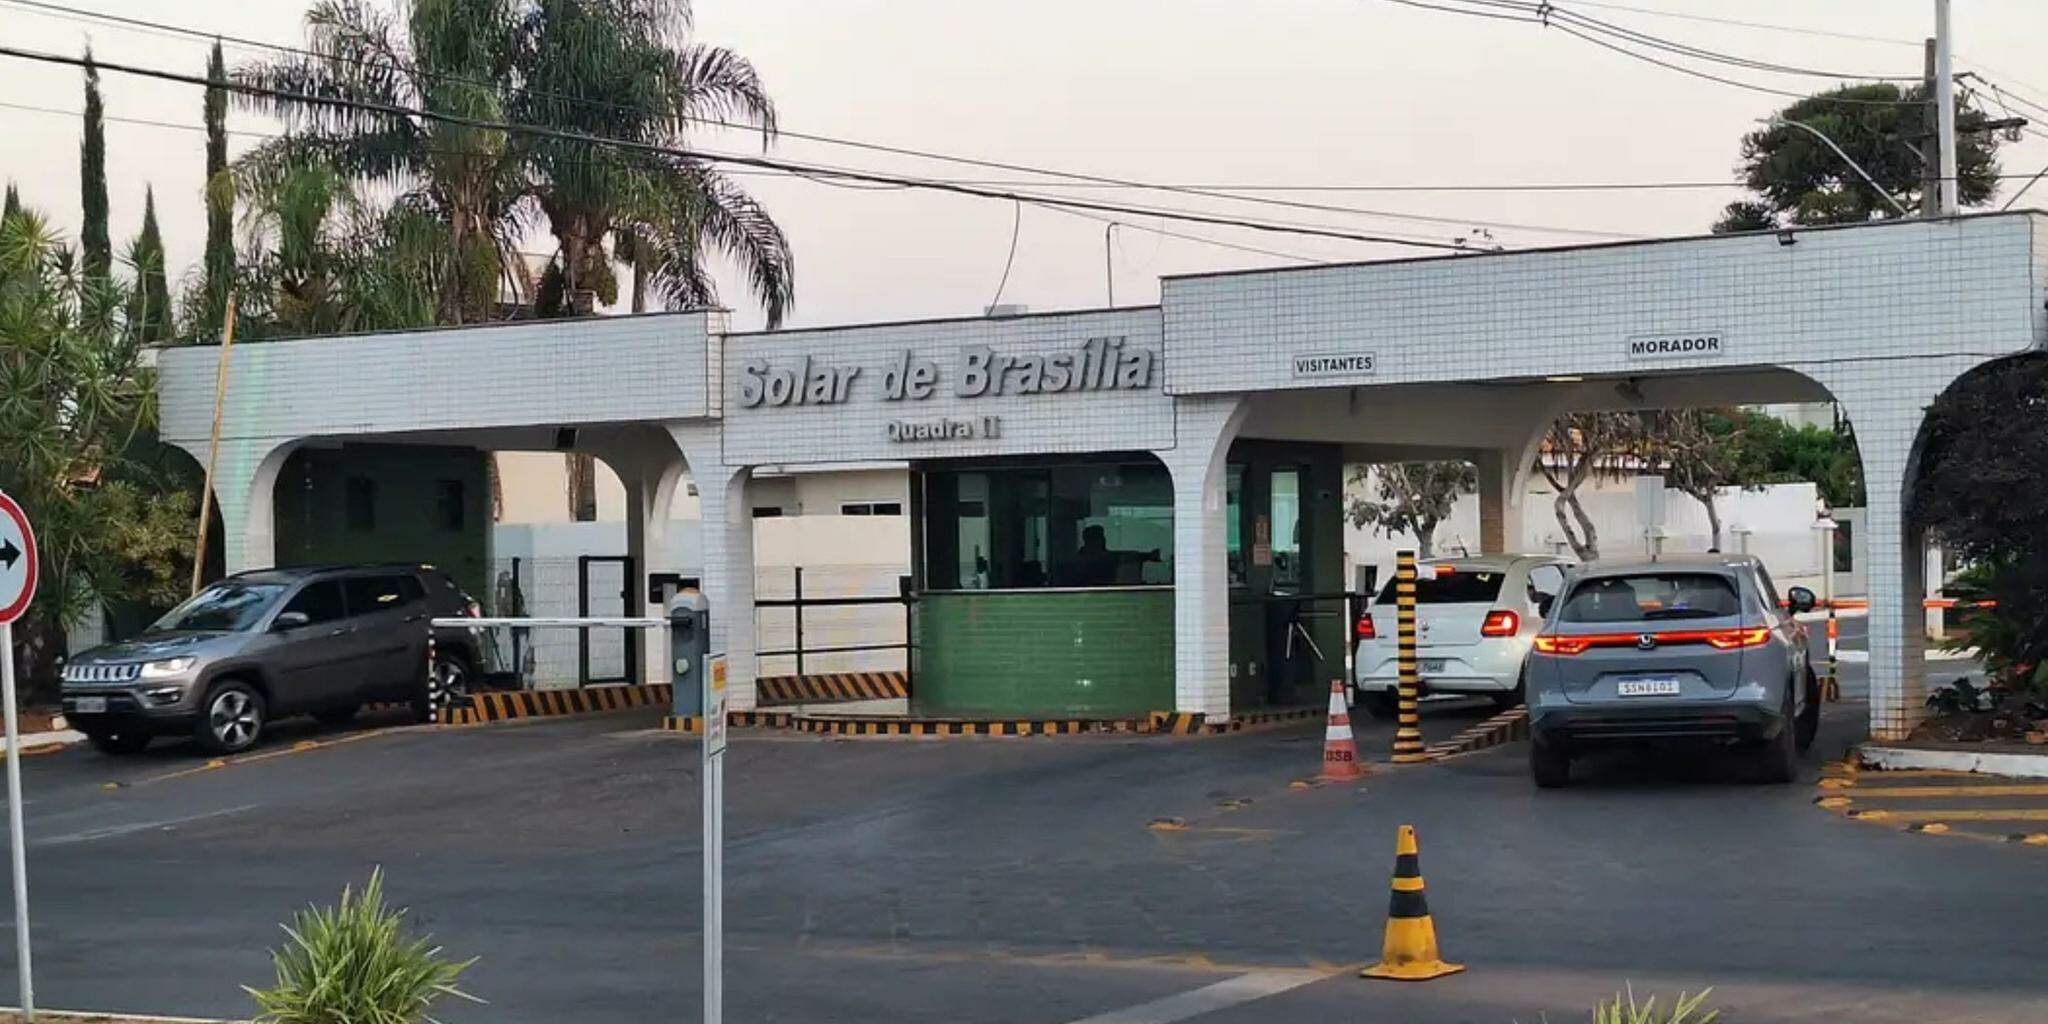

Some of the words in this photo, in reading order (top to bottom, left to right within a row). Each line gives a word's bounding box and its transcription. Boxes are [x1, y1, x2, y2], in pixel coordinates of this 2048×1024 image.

[1632, 337, 1719, 354] MORADOR
[741, 354, 863, 408] Solar
[882, 349, 938, 401] de
[955, 335, 1154, 398] Brasília
[1296, 356, 1373, 373] VISITANTES
[887, 418, 974, 443] Quadra
